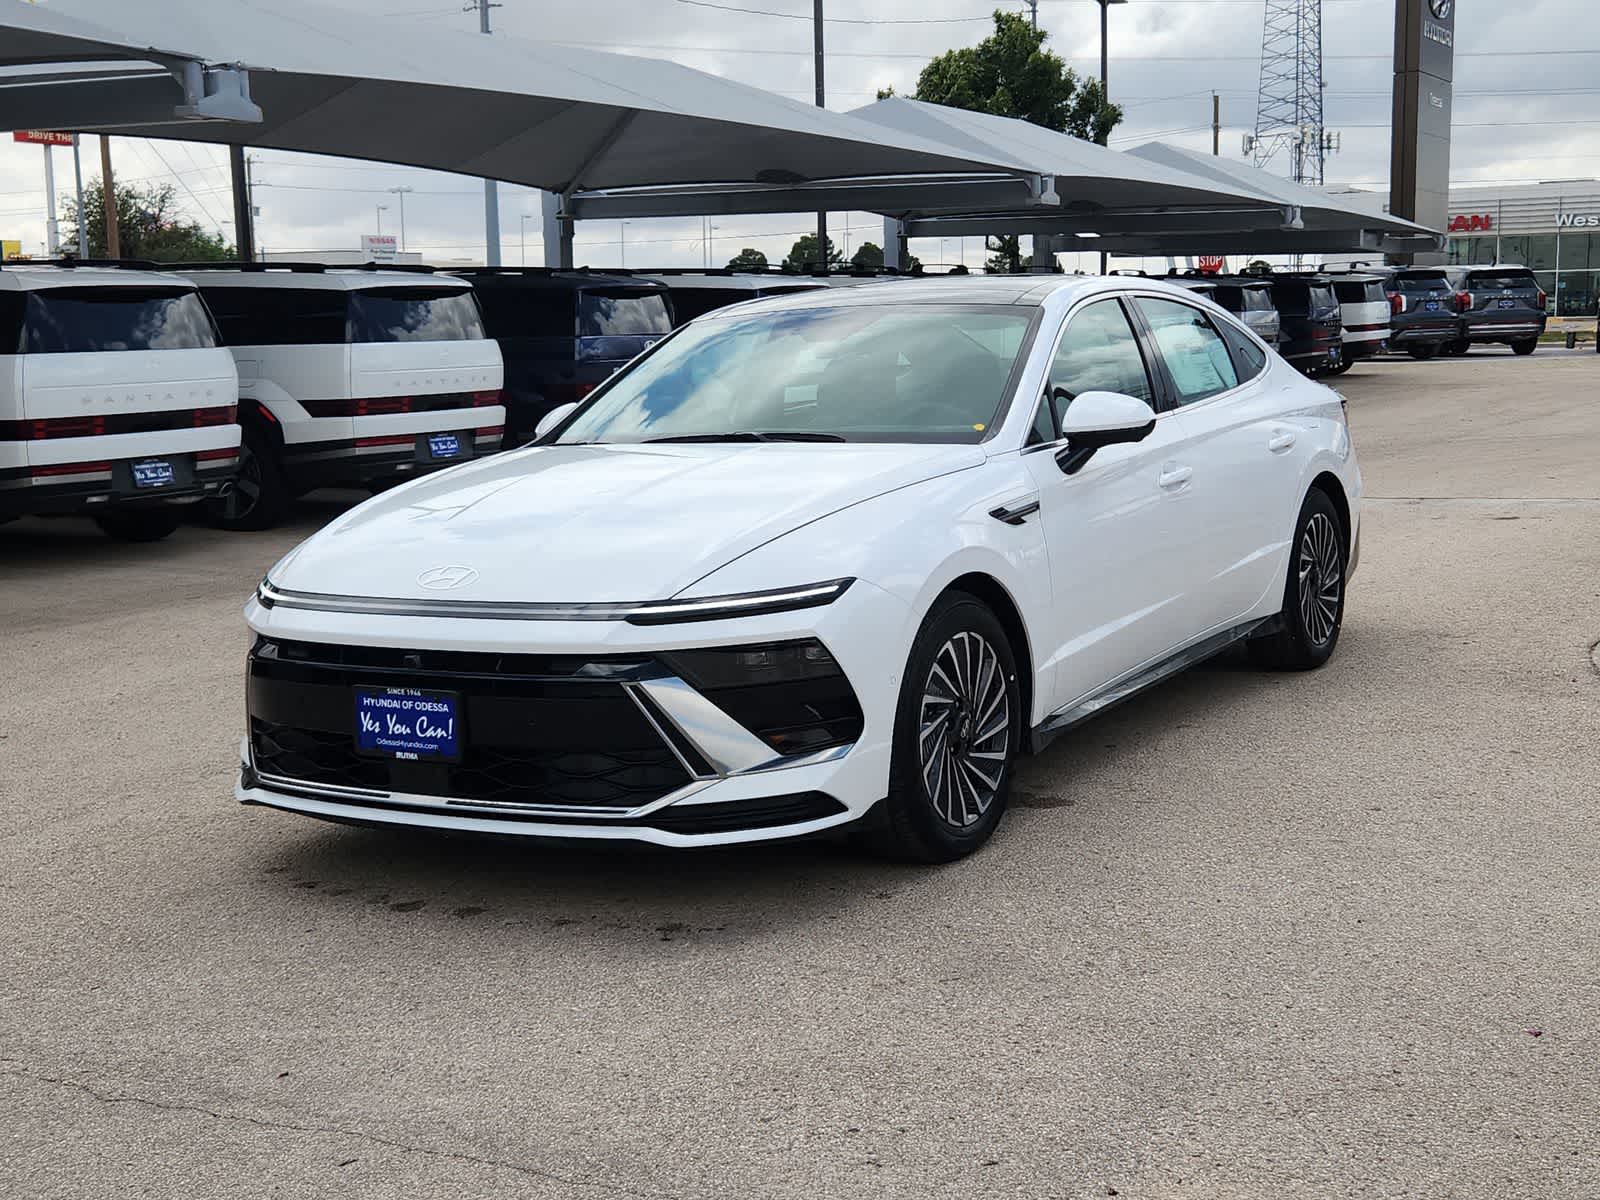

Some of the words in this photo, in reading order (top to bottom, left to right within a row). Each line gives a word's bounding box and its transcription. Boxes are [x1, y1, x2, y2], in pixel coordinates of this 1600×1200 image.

[27, 131, 54, 141] DRIVE
[1200, 255, 1221, 266] STOP
[81, 392, 175, 405] SANTA
[386, 688, 405, 696] SINCE
[363, 697, 401, 709] HYUNDAI
[401, 700, 414, 710] OF
[414, 701, 449, 713] ODESSA
[361, 712, 381, 733] Yes
[387, 713, 411, 735] You
[416, 716, 453, 739] Can!
